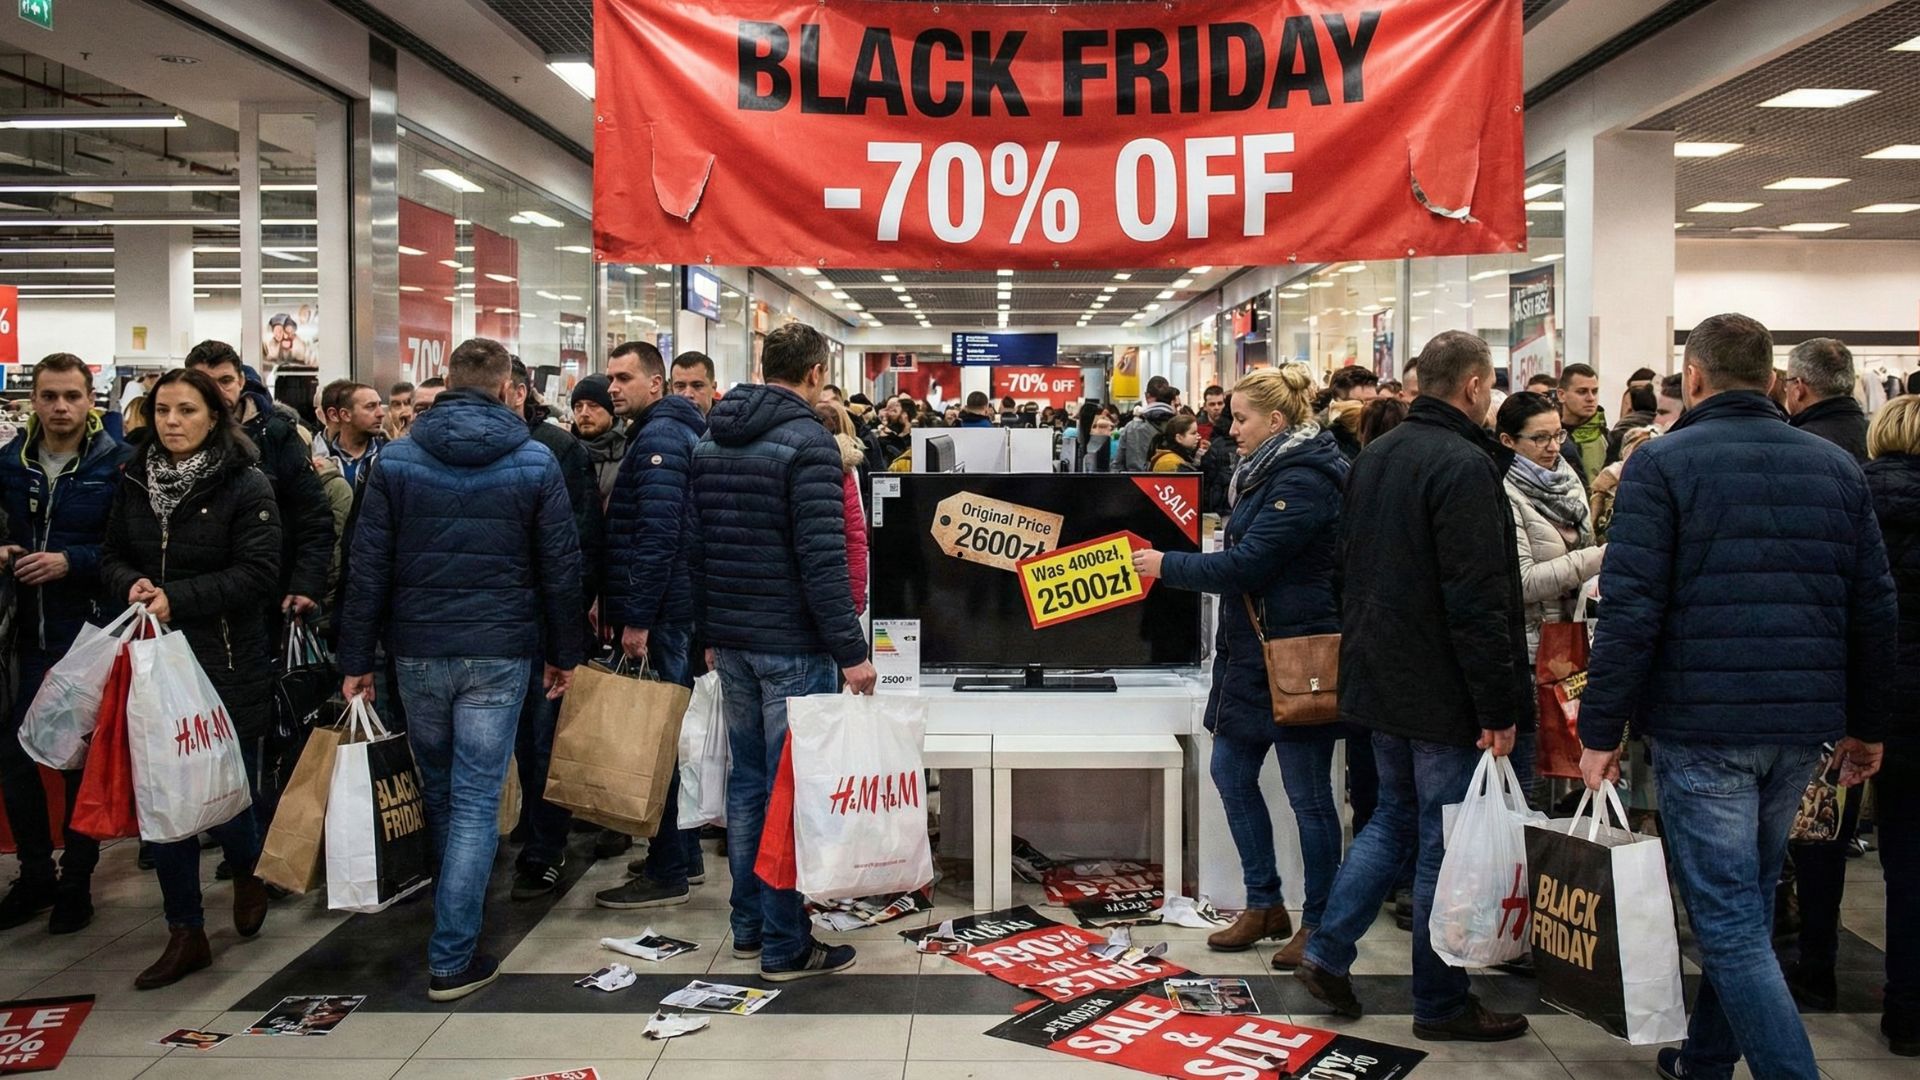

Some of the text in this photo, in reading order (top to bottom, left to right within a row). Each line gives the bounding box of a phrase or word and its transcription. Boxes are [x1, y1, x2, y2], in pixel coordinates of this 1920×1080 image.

[737, 9, 1382, 118] BLACK FRIDAY
[823, 132, 1295, 245] -70% OFF
[1001, 373, 1076, 393] -70% OFF
[961, 501, 1052, 536] Original Price
[1153, 484, 1197, 526] -SALE
[1031, 544, 1125, 583] Was 4000zł,
[1037, 565, 1133, 616] 2500zł
[881, 675, 905, 684] 2500
[375, 769, 420, 811] BLACK
[380, 800, 426, 842] FRIDAY
[1535, 873, 1601, 933] BLACK
[1530, 910, 1599, 971] FRIDAY
[1066, 1000, 1181, 1055] SALE
[1161, 1031, 1213, 1048] &
